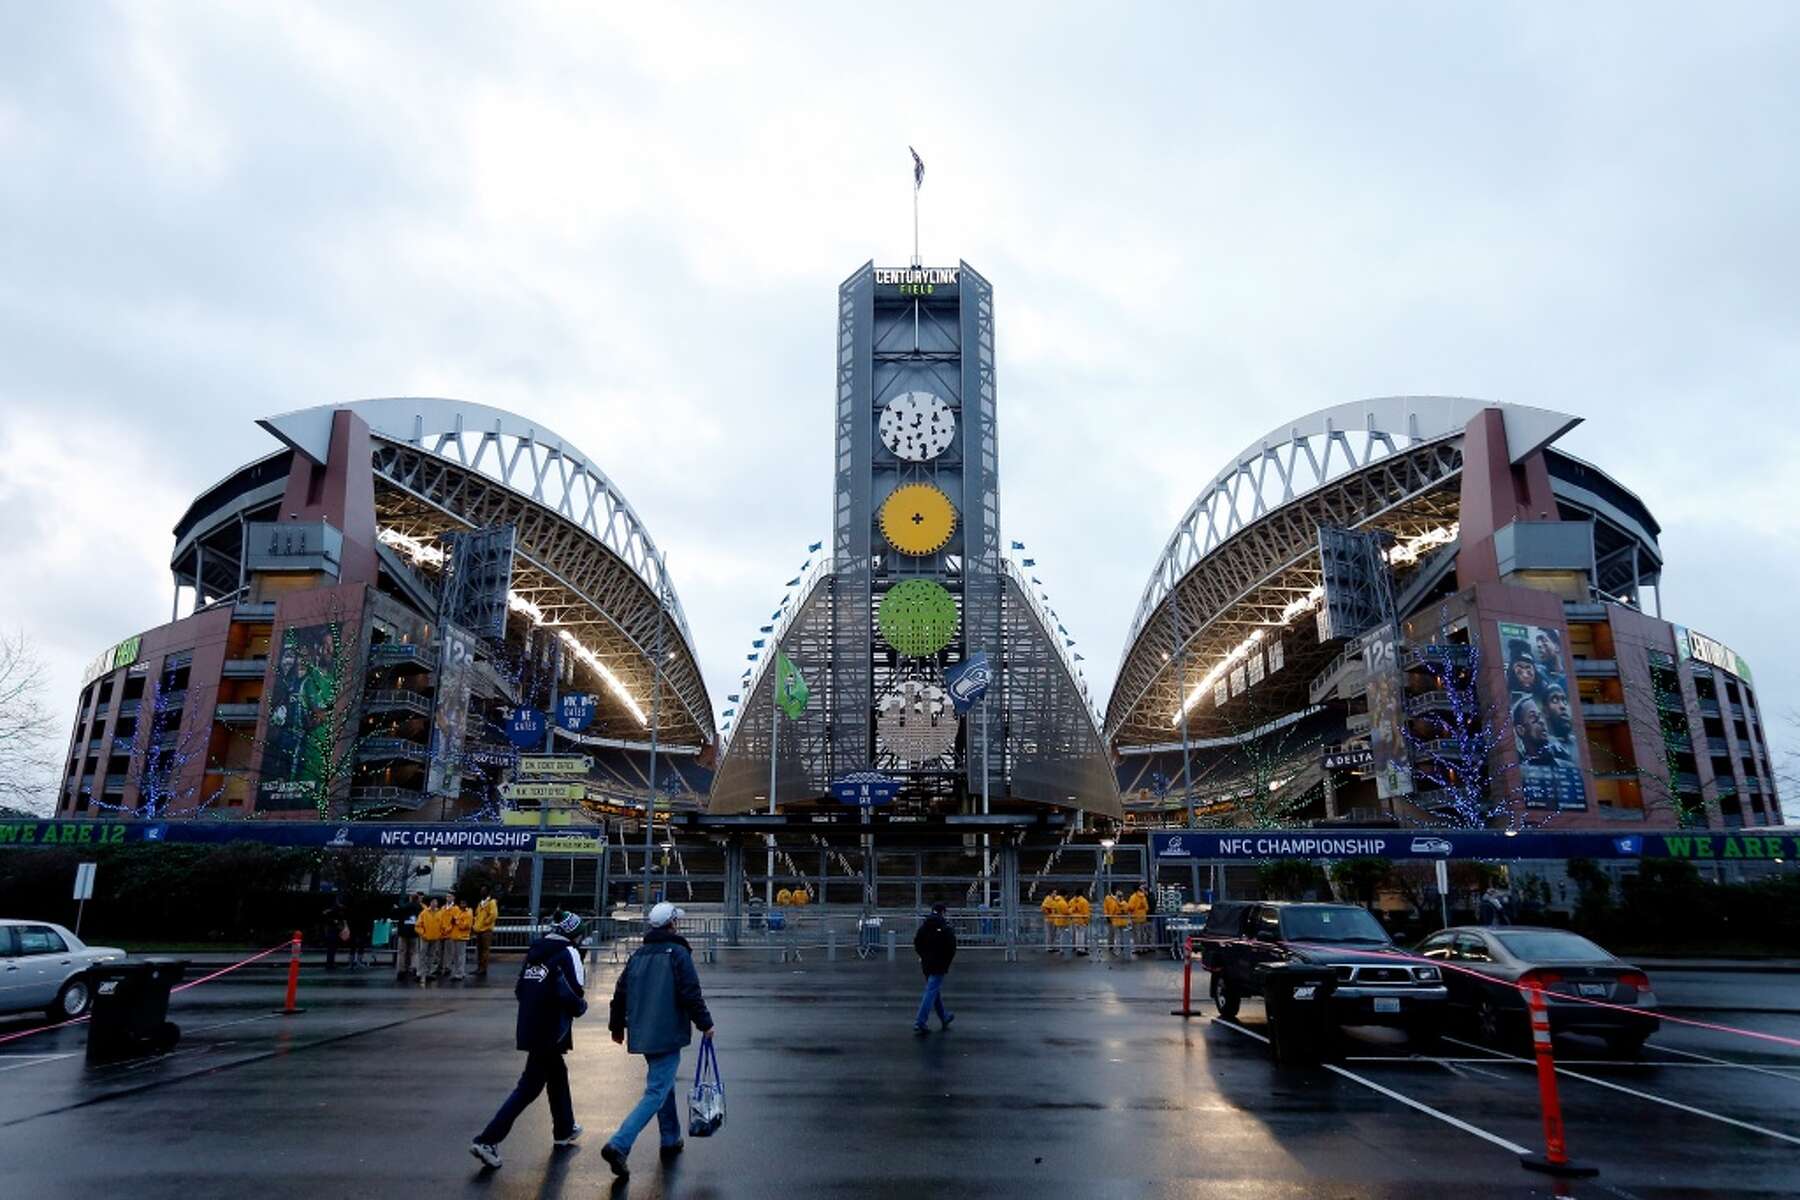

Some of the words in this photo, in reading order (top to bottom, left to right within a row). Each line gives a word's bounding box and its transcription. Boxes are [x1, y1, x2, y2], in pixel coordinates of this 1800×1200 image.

[876, 268, 957, 284] CENTURYLINK
[900, 284, 934, 294] FIELD
[1336, 752, 1373, 765] DELTA
[0, 824, 37, 843] WE
[42, 824, 94, 843] ARE
[99, 824, 126, 844] 12
[380, 831, 410, 845] NFC
[414, 831, 531, 846] CHAMPIONSHIP
[1219, 839, 1252, 854] NFC
[1257, 839, 1386, 854] CHAMPIONSHIP
[1664, 837, 1714, 857] WE
[1723, 837, 1784, 858] ARE
